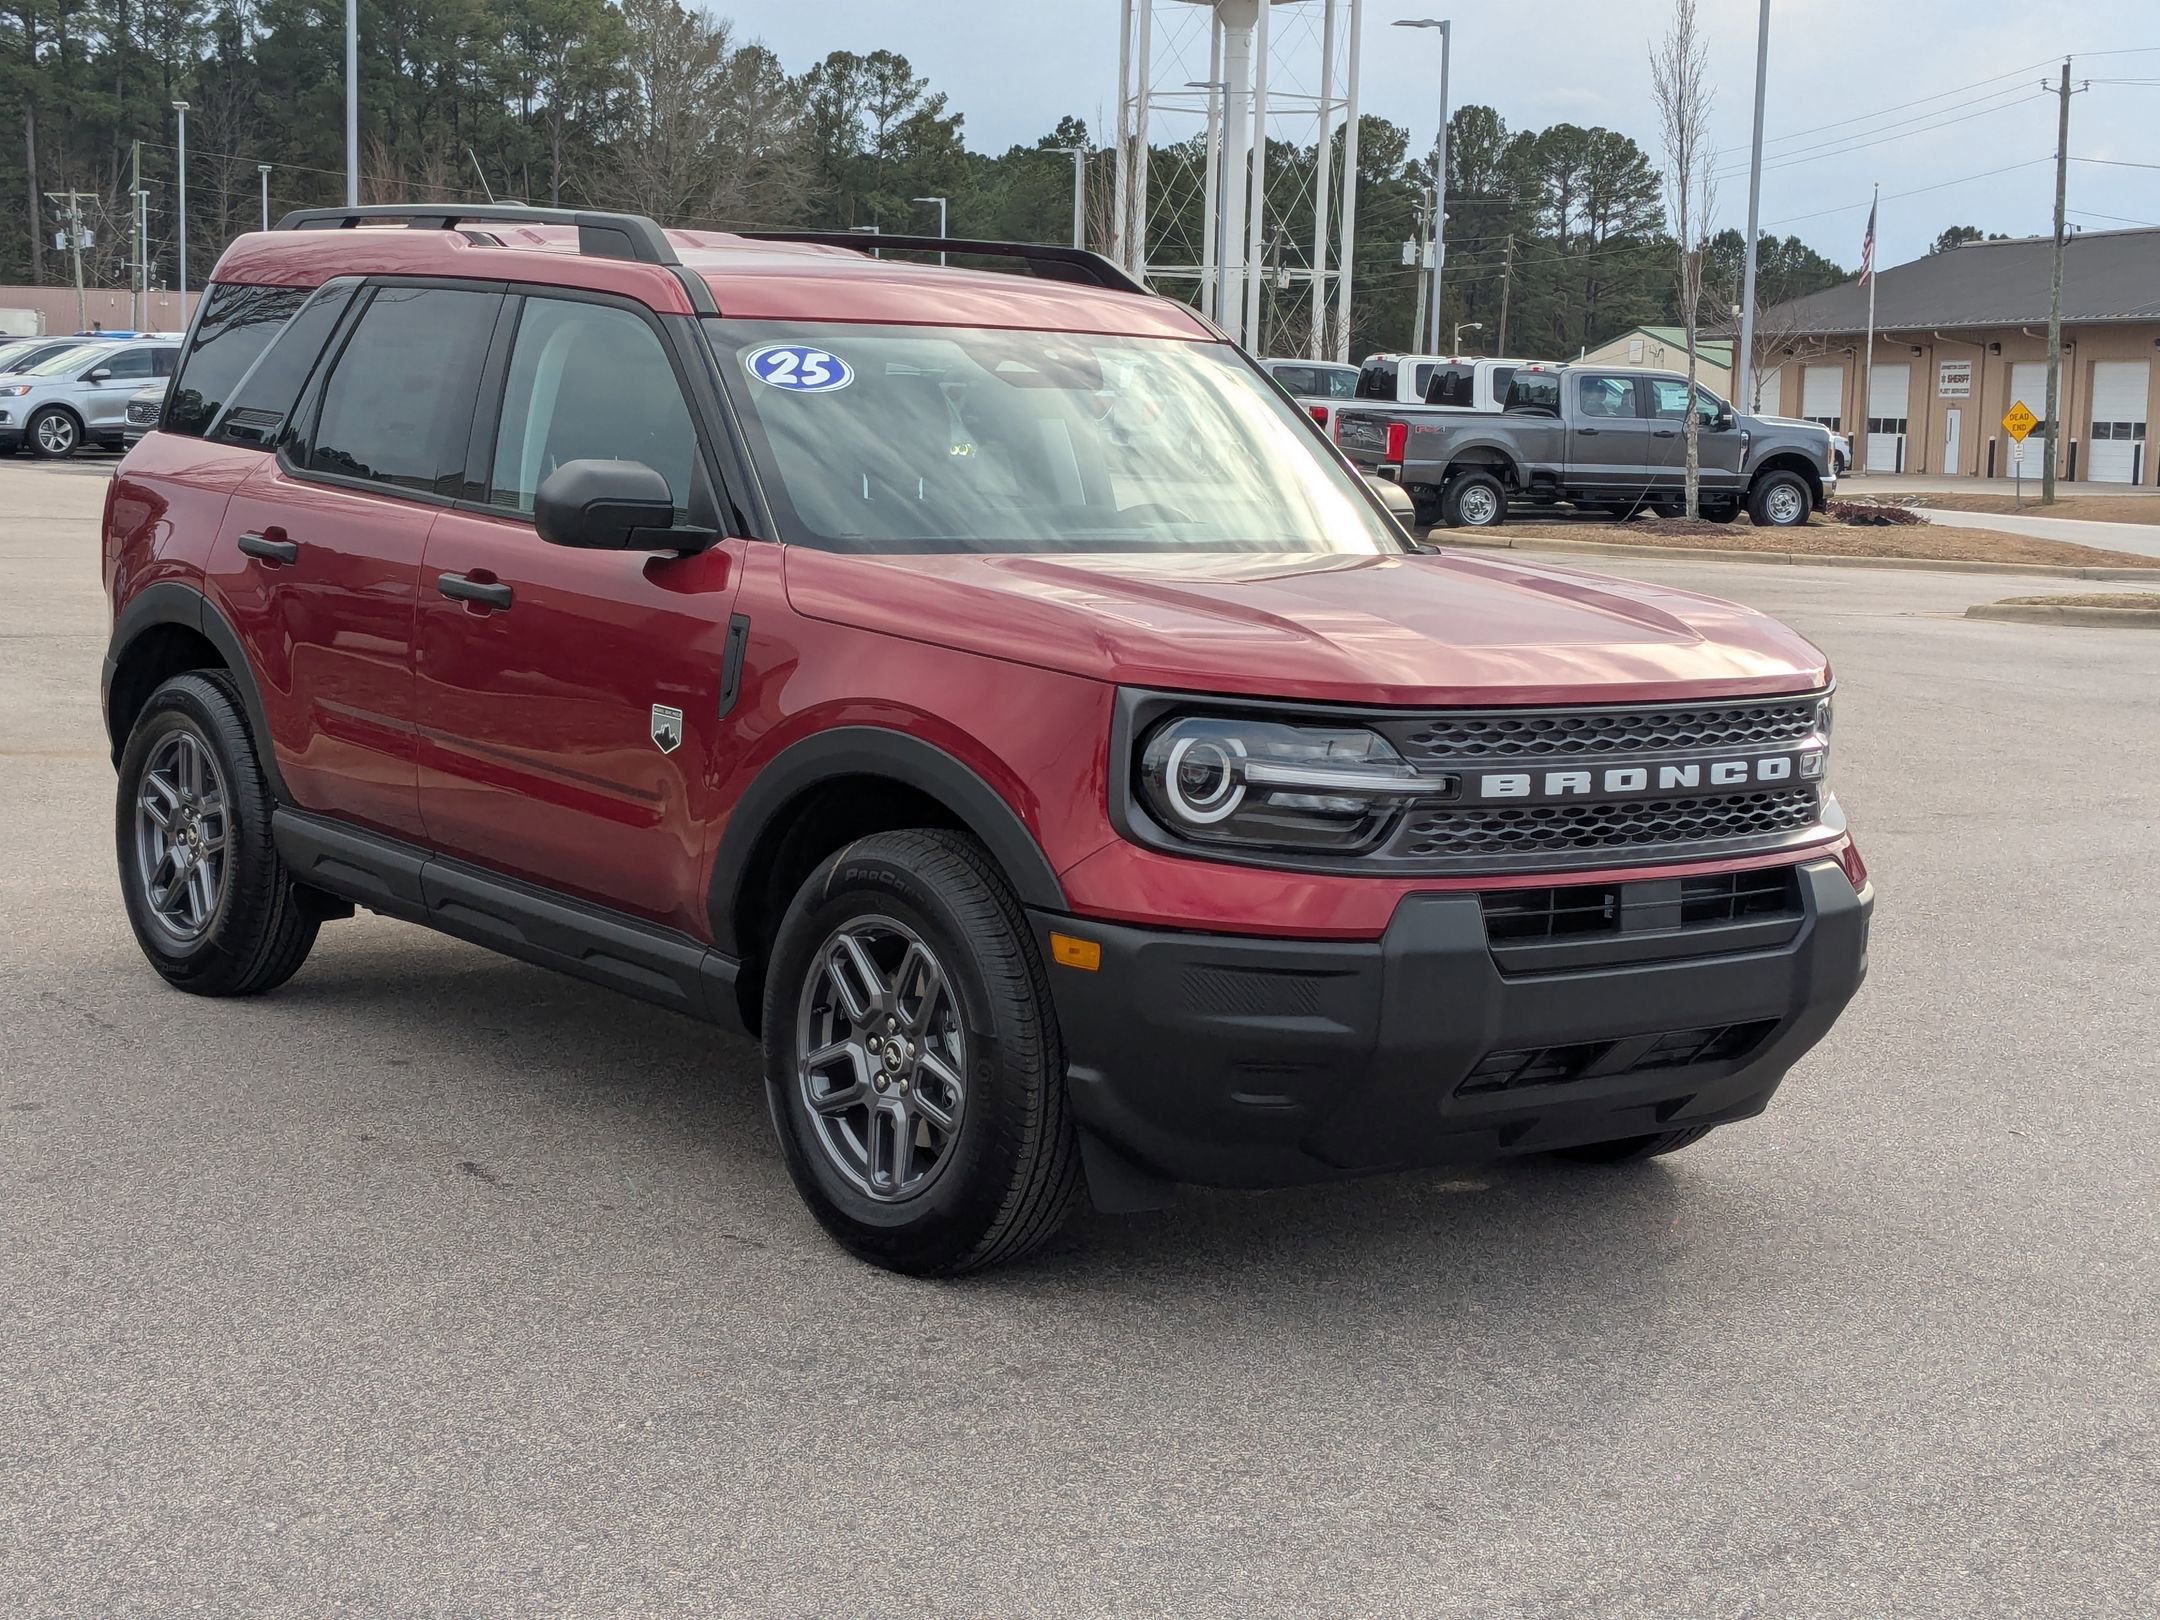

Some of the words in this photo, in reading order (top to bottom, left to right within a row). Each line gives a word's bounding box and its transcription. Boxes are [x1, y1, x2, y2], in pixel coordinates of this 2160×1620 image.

[765, 350, 831, 386] 25
[2009, 412, 2030, 421] DEAD
[2012, 423, 2027, 432] END
[1480, 757, 1791, 798] BRONCO
